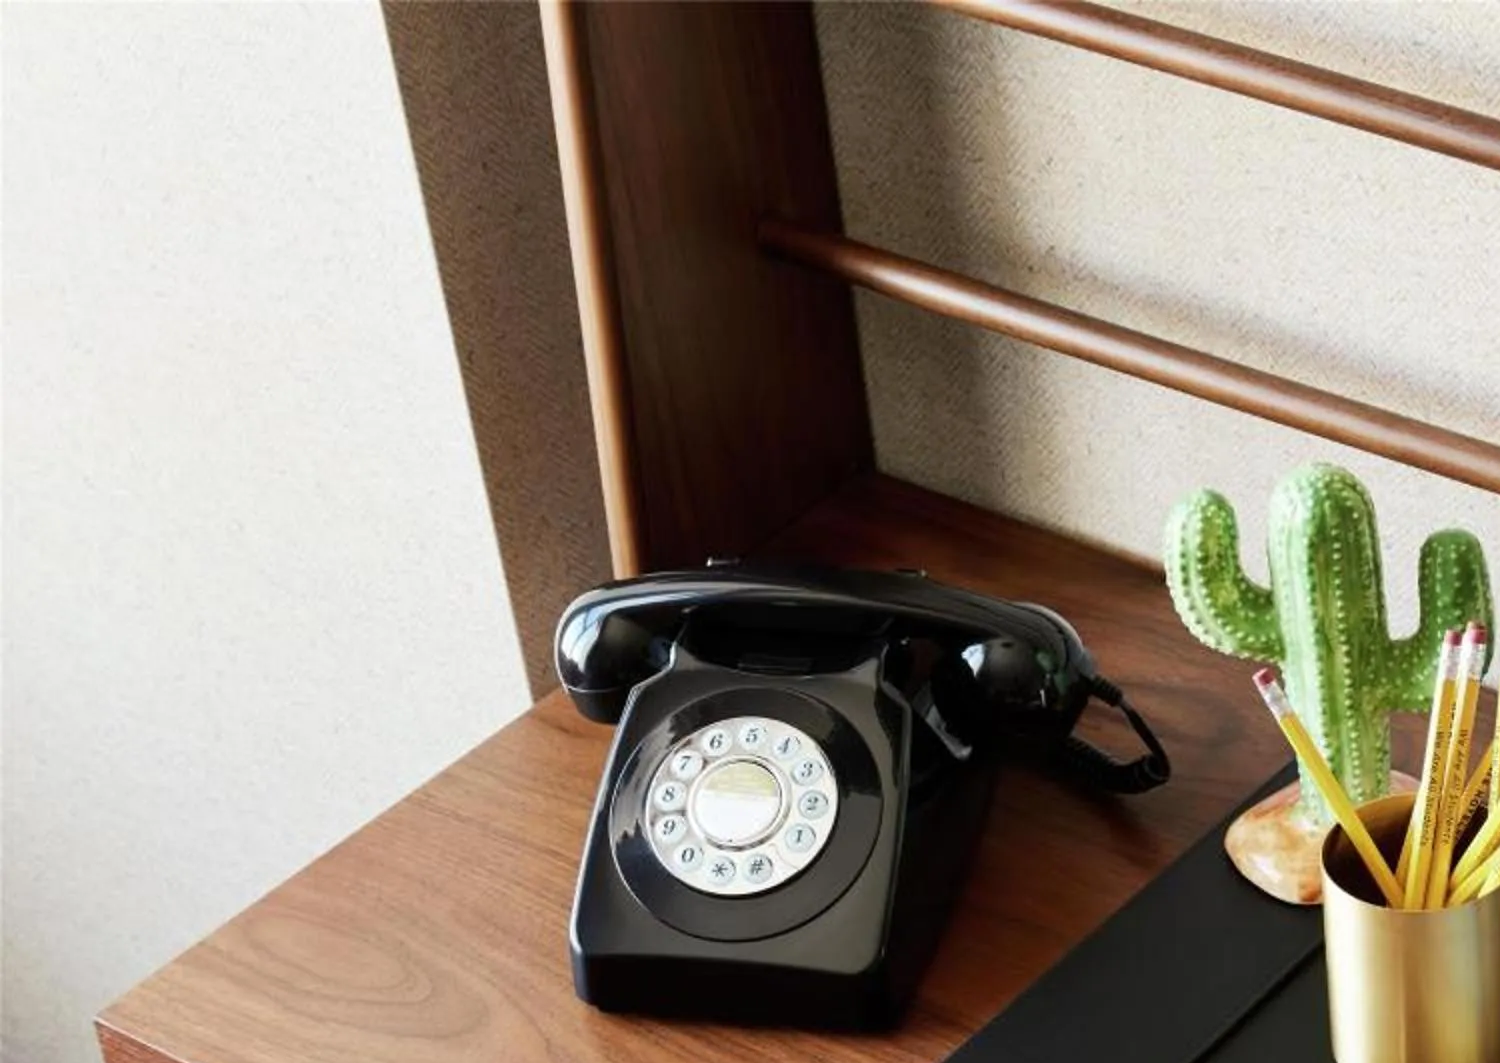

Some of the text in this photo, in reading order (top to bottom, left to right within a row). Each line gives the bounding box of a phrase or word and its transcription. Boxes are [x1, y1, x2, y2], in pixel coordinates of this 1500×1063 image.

[710, 734, 724, 750] 6
[746, 728, 758, 743] 5
[680, 755, 691, 771] 7
[801, 761, 814, 777] 3
[662, 786, 675, 802] 8
[806, 796, 819, 811] 2
[663, 820, 676, 836] 9
[681, 847, 694, 863] 0
[750, 859, 764, 874] #
